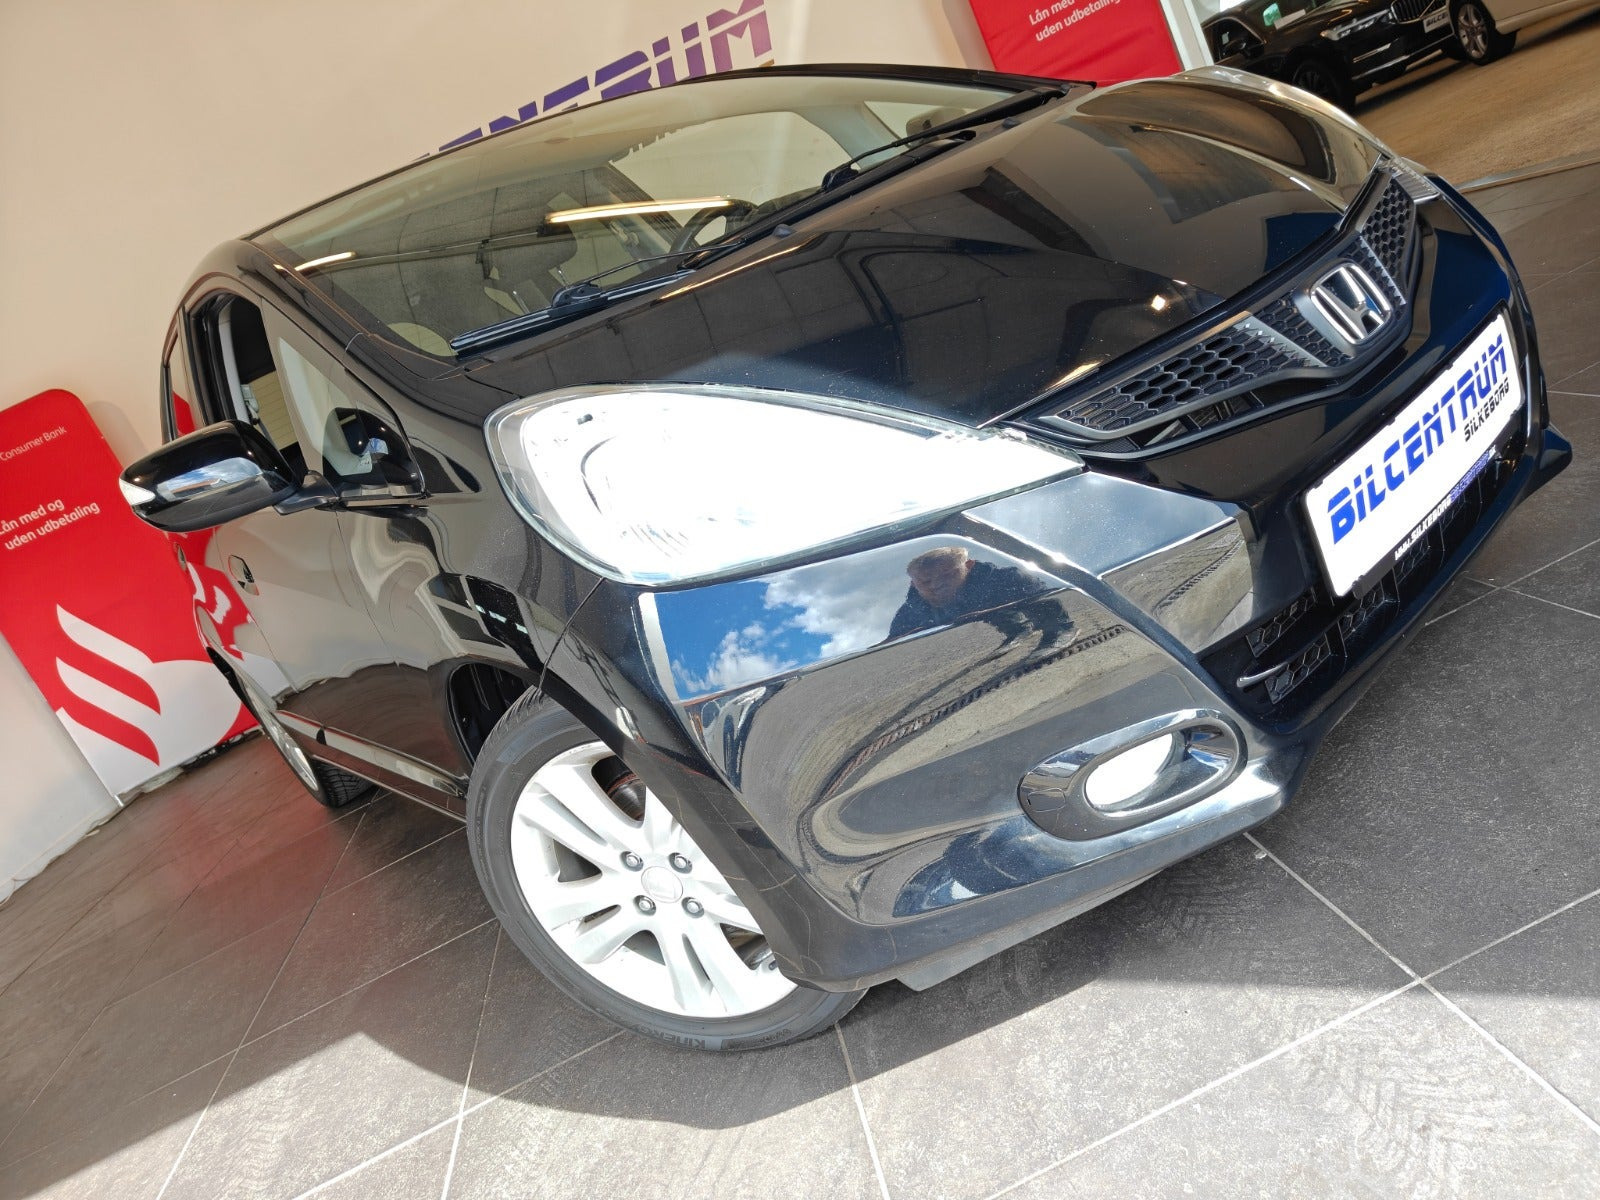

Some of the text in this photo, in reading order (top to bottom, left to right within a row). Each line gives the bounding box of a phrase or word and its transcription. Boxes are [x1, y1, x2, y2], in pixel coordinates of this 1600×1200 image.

[1029, 9, 1050, 26] Lån
[1035, 21, 1063, 42] uden
[1464, 377, 1509, 442] SILKEBORG
[0, 425, 67, 462] Consumer Bank
[1327, 333, 1507, 545] BILCENTRUM
[4, 501, 101, 551] uden udbetaling
[19, 504, 47, 526] med
[47, 498, 65, 513] og
